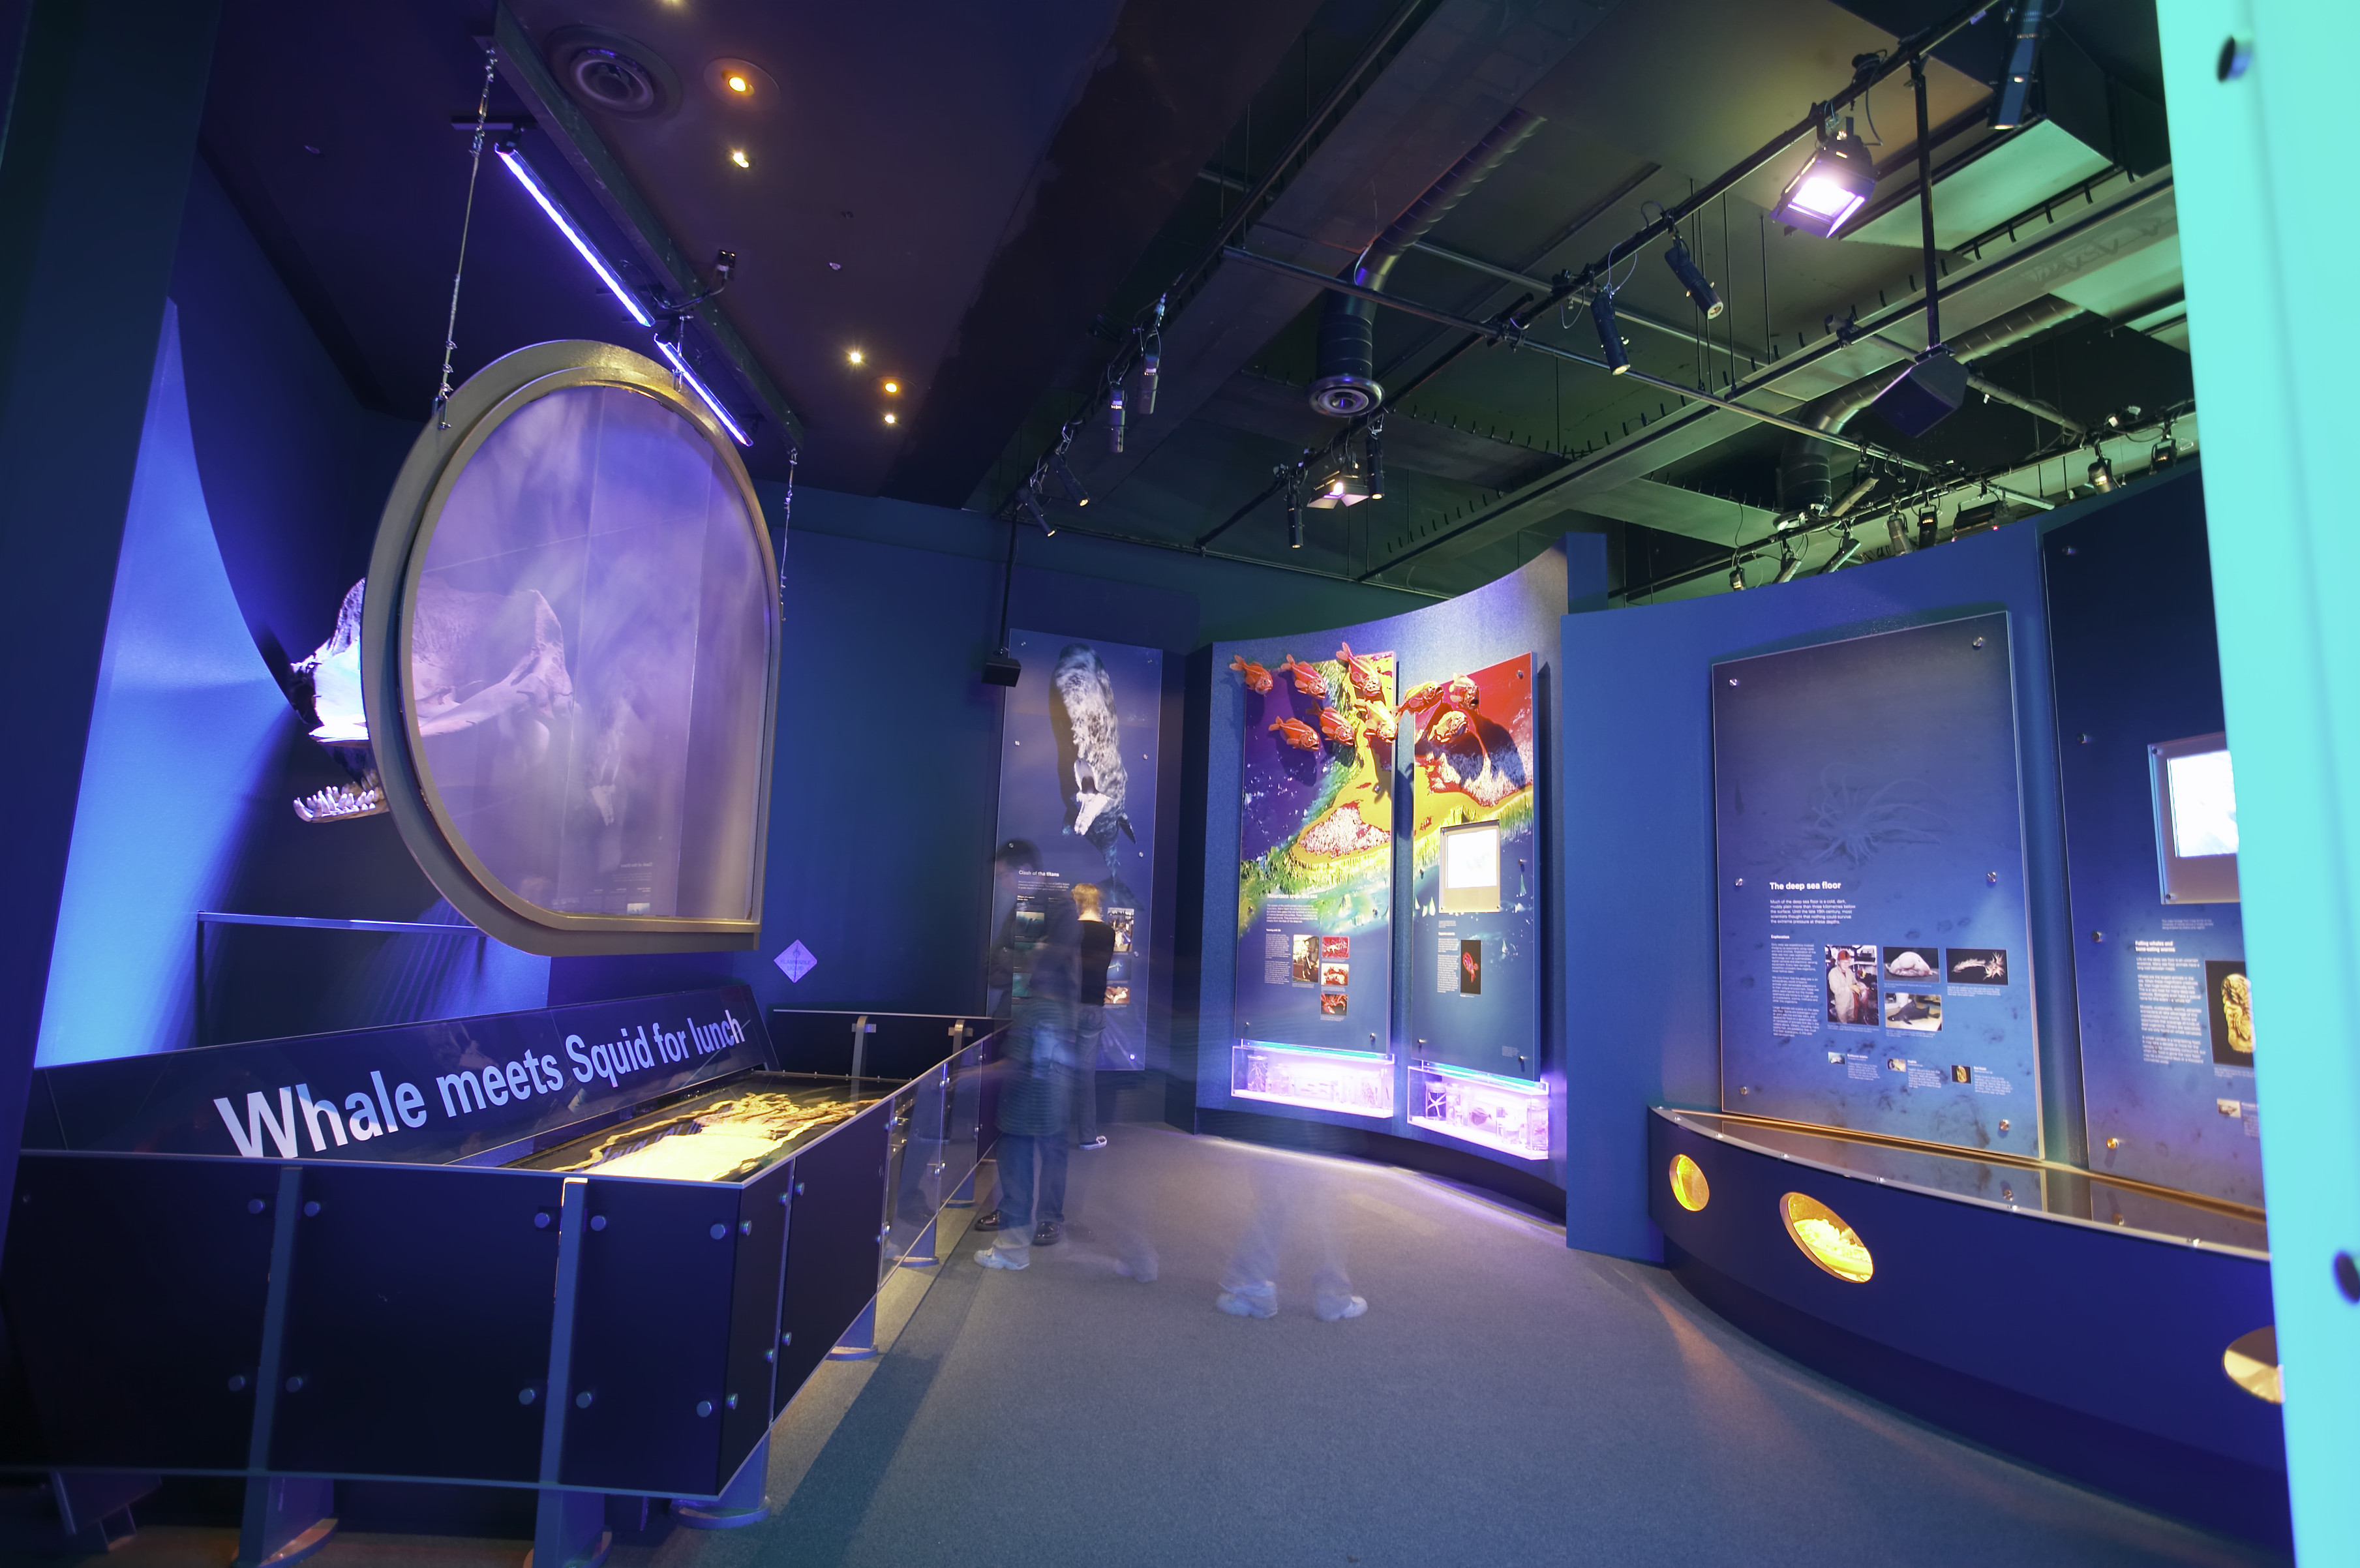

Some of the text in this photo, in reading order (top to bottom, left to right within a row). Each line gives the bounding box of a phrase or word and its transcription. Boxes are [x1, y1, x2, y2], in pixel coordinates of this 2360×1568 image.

[1786, 882, 1805, 891] deep
[1822, 881, 1841, 889] floor
[213, 1010, 746, 1158] Whale meets Squid for lunch
